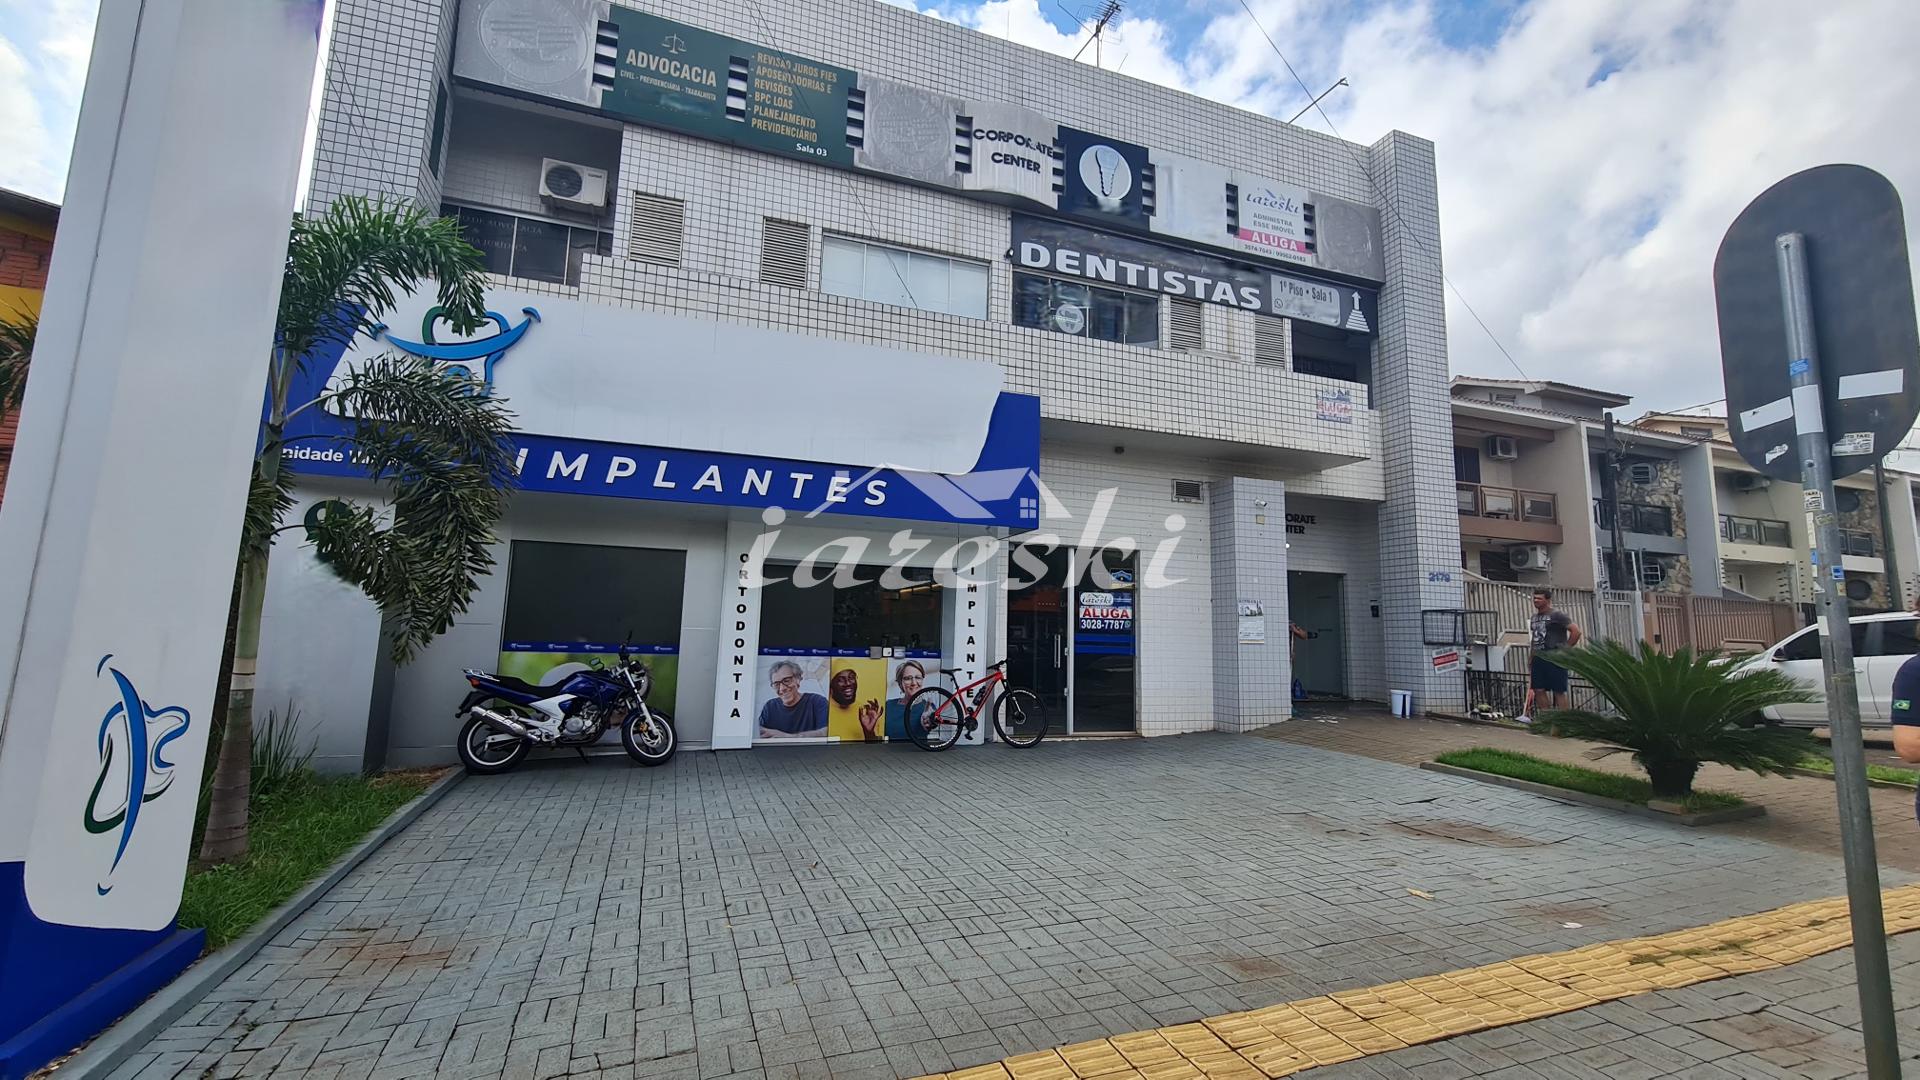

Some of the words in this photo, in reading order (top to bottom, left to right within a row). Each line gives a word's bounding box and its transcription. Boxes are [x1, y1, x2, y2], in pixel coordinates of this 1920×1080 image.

[626, 48, 716, 87] ADVOCACIA
[793, 62, 818, 77] JUROS
[820, 70, 837, 82] FIES
[756, 65, 825, 92] APOSENTADORIAS
[827, 84, 832, 94] E
[754, 91, 772, 105] BPC
[773, 96, 793, 109] LOAS
[753, 105, 816, 129] PLANEJAMENTO
[796, 142, 815, 155] Sala
[816, 146, 828, 157] 03
[973, 129, 1054, 158] CORPORATE
[991, 152, 1041, 174] CENTER
[1253, 212, 1293, 227] ADMINISTRA
[1253, 220, 1270, 230] ESSE
[1251, 231, 1298, 252] ALUGA
[1020, 242, 1262, 310] DENTISTAS
[1288, 282, 1304, 297] Piso
[1311, 287, 1327, 302] Sala
[1328, 291, 1333, 303] 1
[281, 446, 344, 462] nidade
[511, 447, 888, 506] IMPLANTES
[1285, 513, 1317, 525] ORATE
[1082, 607, 1130, 619] ALUGA
[730, 553, 750, 718] ORTODONTIA
[1081, 620, 1125, 630] 3028-7787
